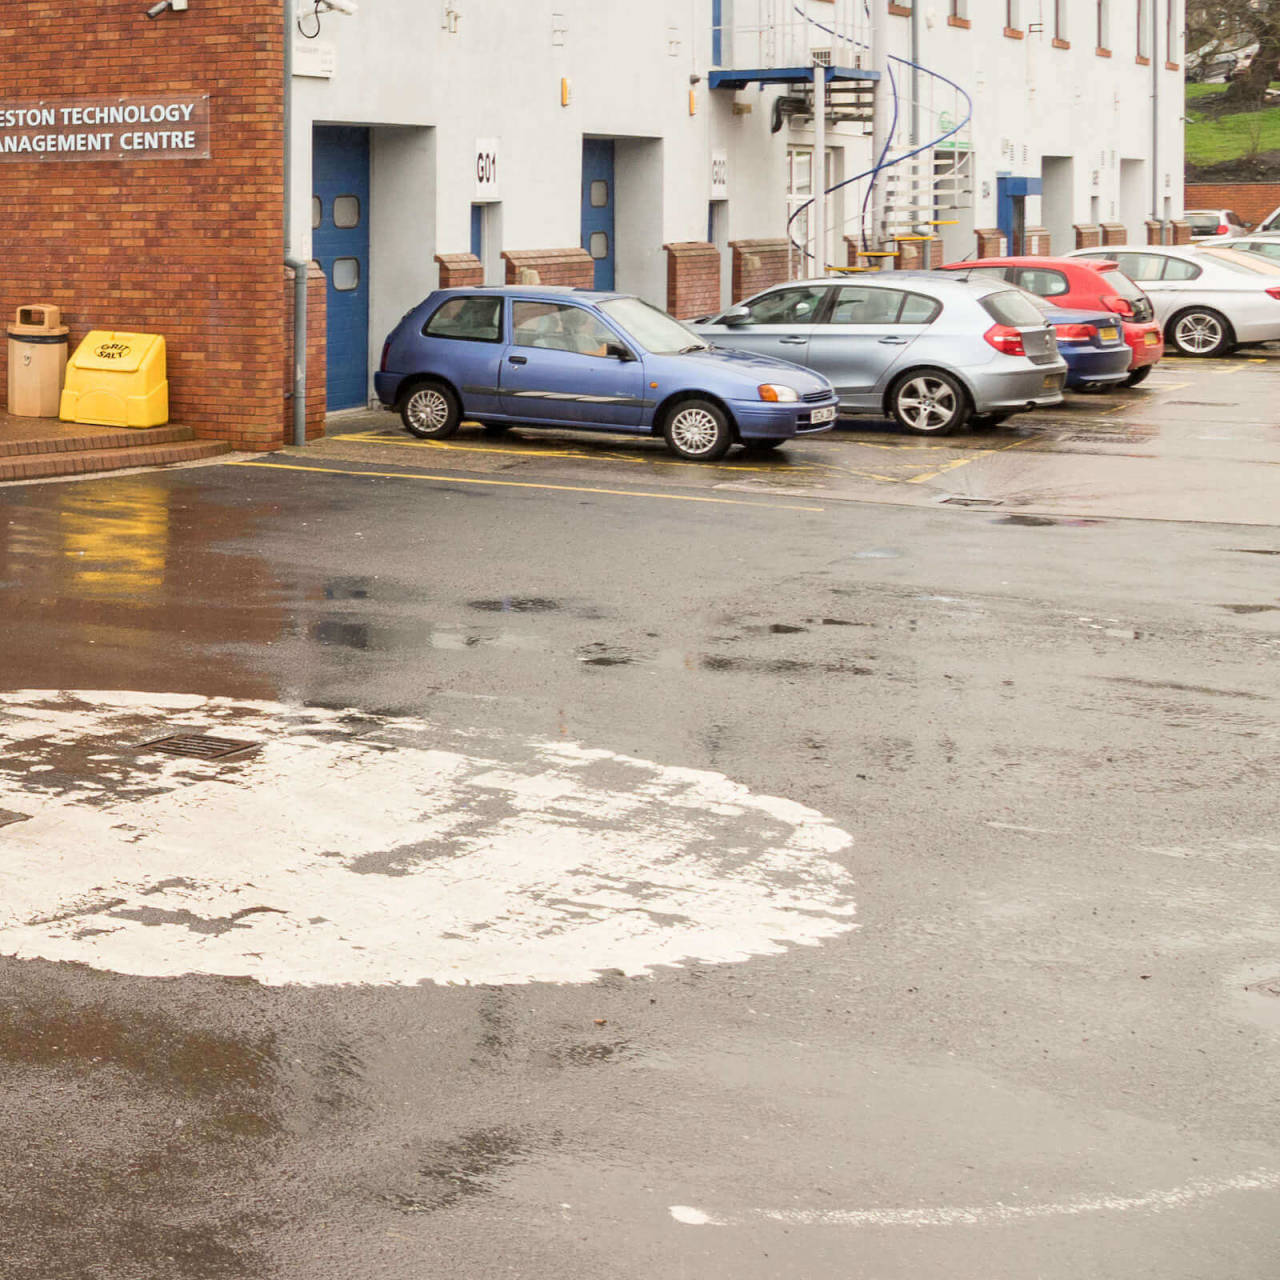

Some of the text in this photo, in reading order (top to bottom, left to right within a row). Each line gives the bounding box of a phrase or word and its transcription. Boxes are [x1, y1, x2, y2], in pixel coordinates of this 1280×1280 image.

[60, 104, 194, 125] TECHNOLOGY
[120, 131, 195, 150] CENTRE
[476, 152, 496, 183] G01
[97, 350, 123, 359] SALT
[100, 343, 129, 351] GRIT
